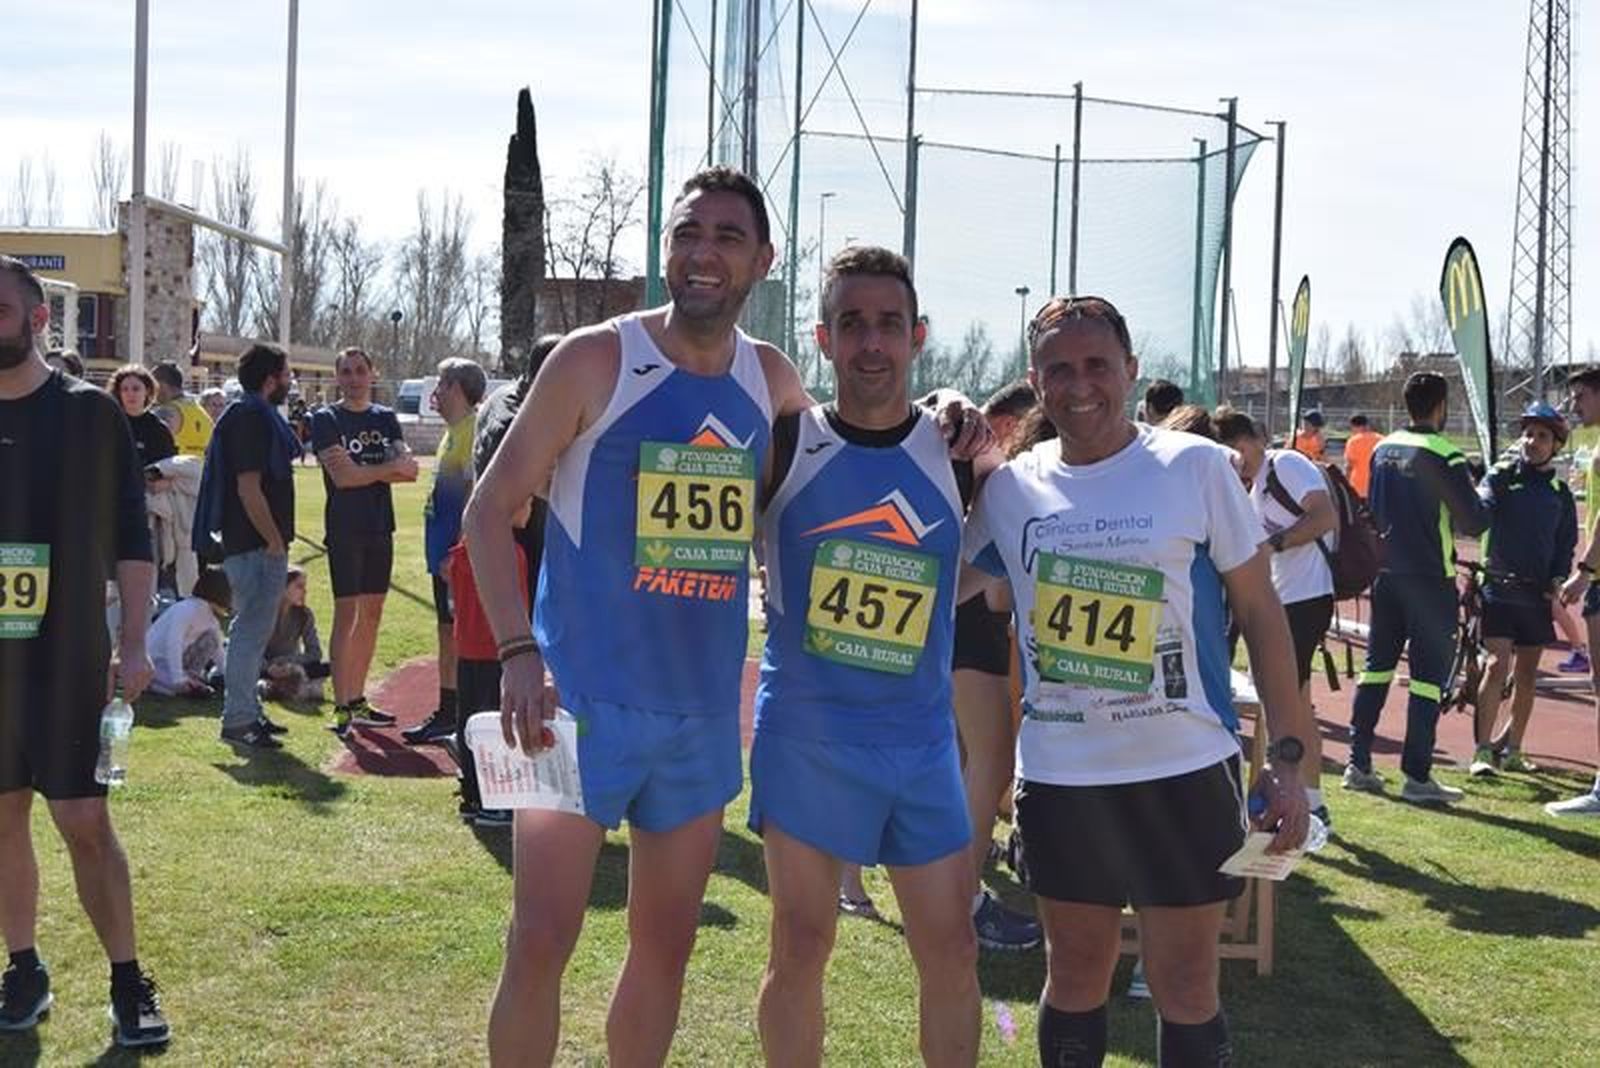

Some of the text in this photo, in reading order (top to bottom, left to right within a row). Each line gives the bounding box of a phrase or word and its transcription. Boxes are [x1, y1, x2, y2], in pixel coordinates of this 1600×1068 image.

[650, 481, 743, 532] 456
[1095, 514, 1153, 532] Dental
[674, 547, 708, 560] CAJA
[819, 577, 923, 635] 457
[1047, 594, 1136, 653] 414
[835, 640, 914, 666] CAJA RURAL
[1057, 659, 1091, 676] CAJA
[1094, 662, 1143, 684] RURAL
